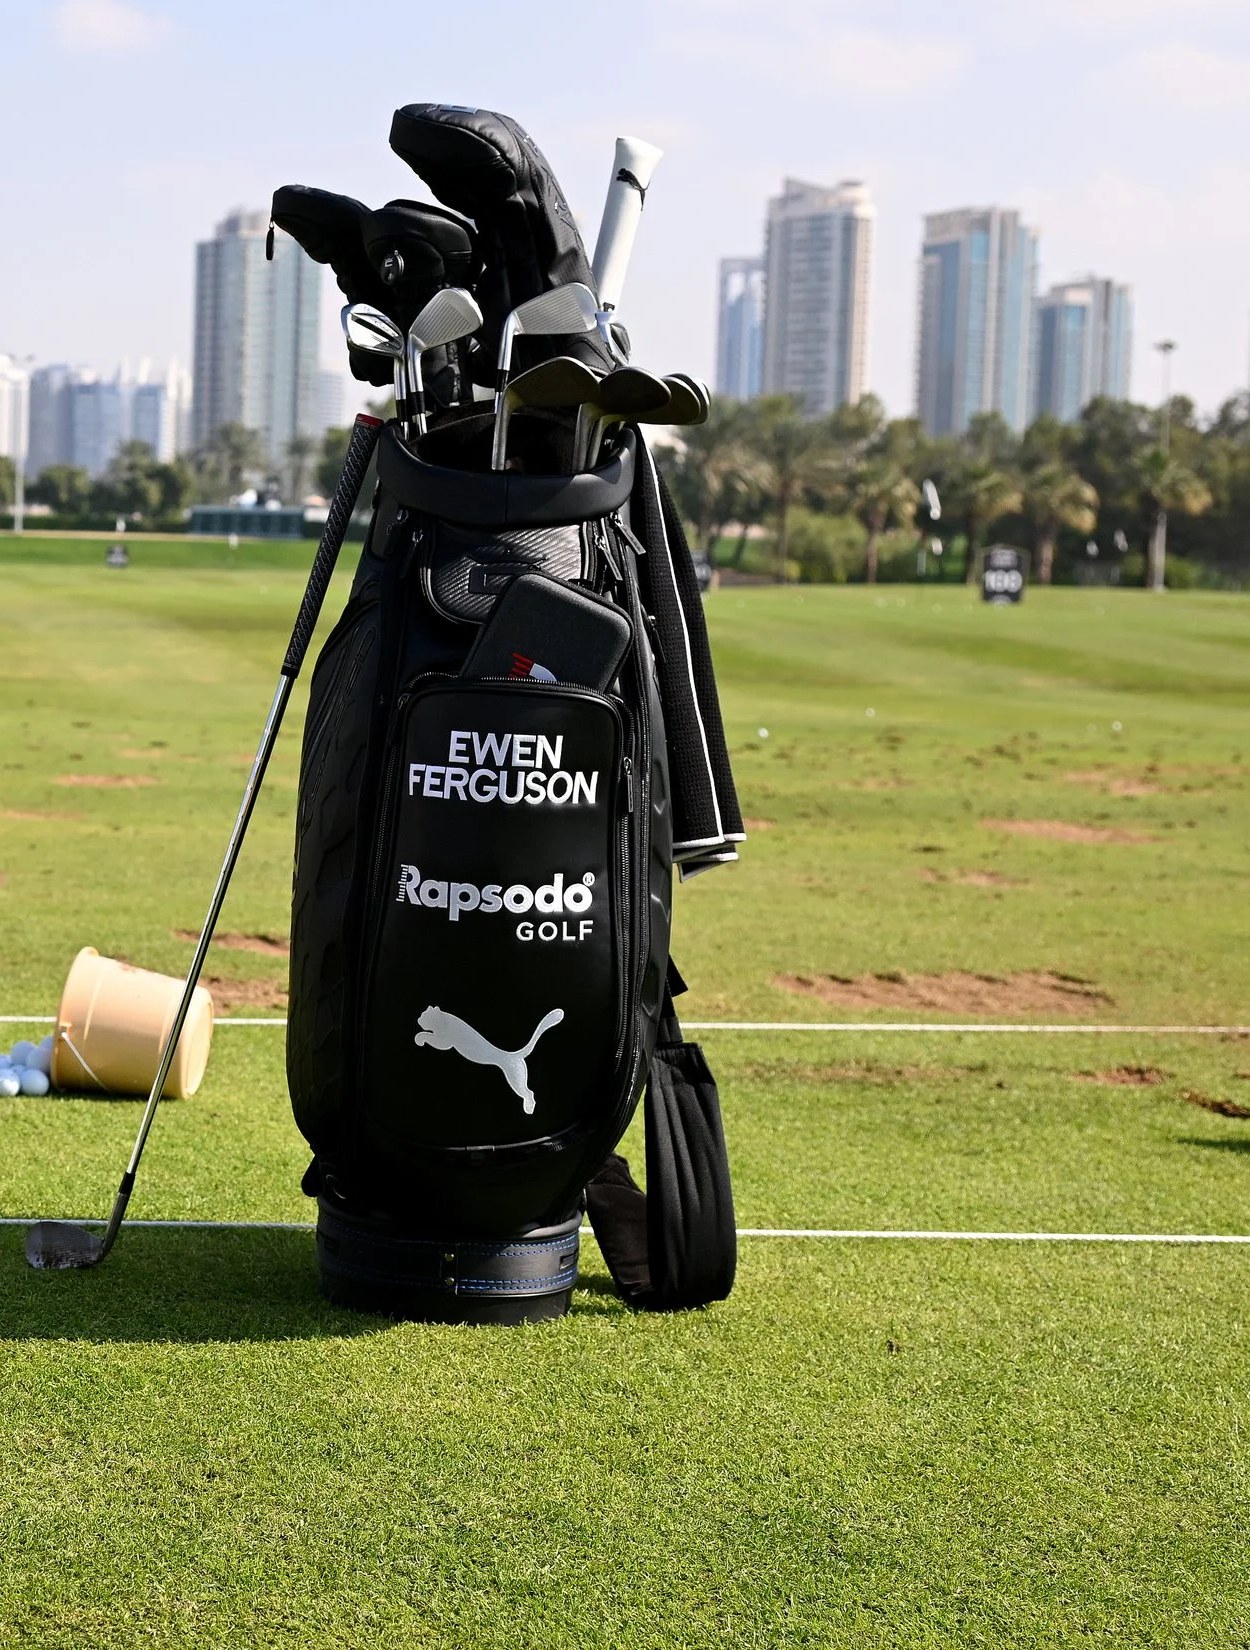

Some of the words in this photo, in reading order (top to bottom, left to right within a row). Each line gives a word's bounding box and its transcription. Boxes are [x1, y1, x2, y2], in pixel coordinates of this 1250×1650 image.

[448, 730, 564, 769] EWEN
[408, 763, 599, 805] FERGUSON
[515, 920, 594, 942] GOLF
